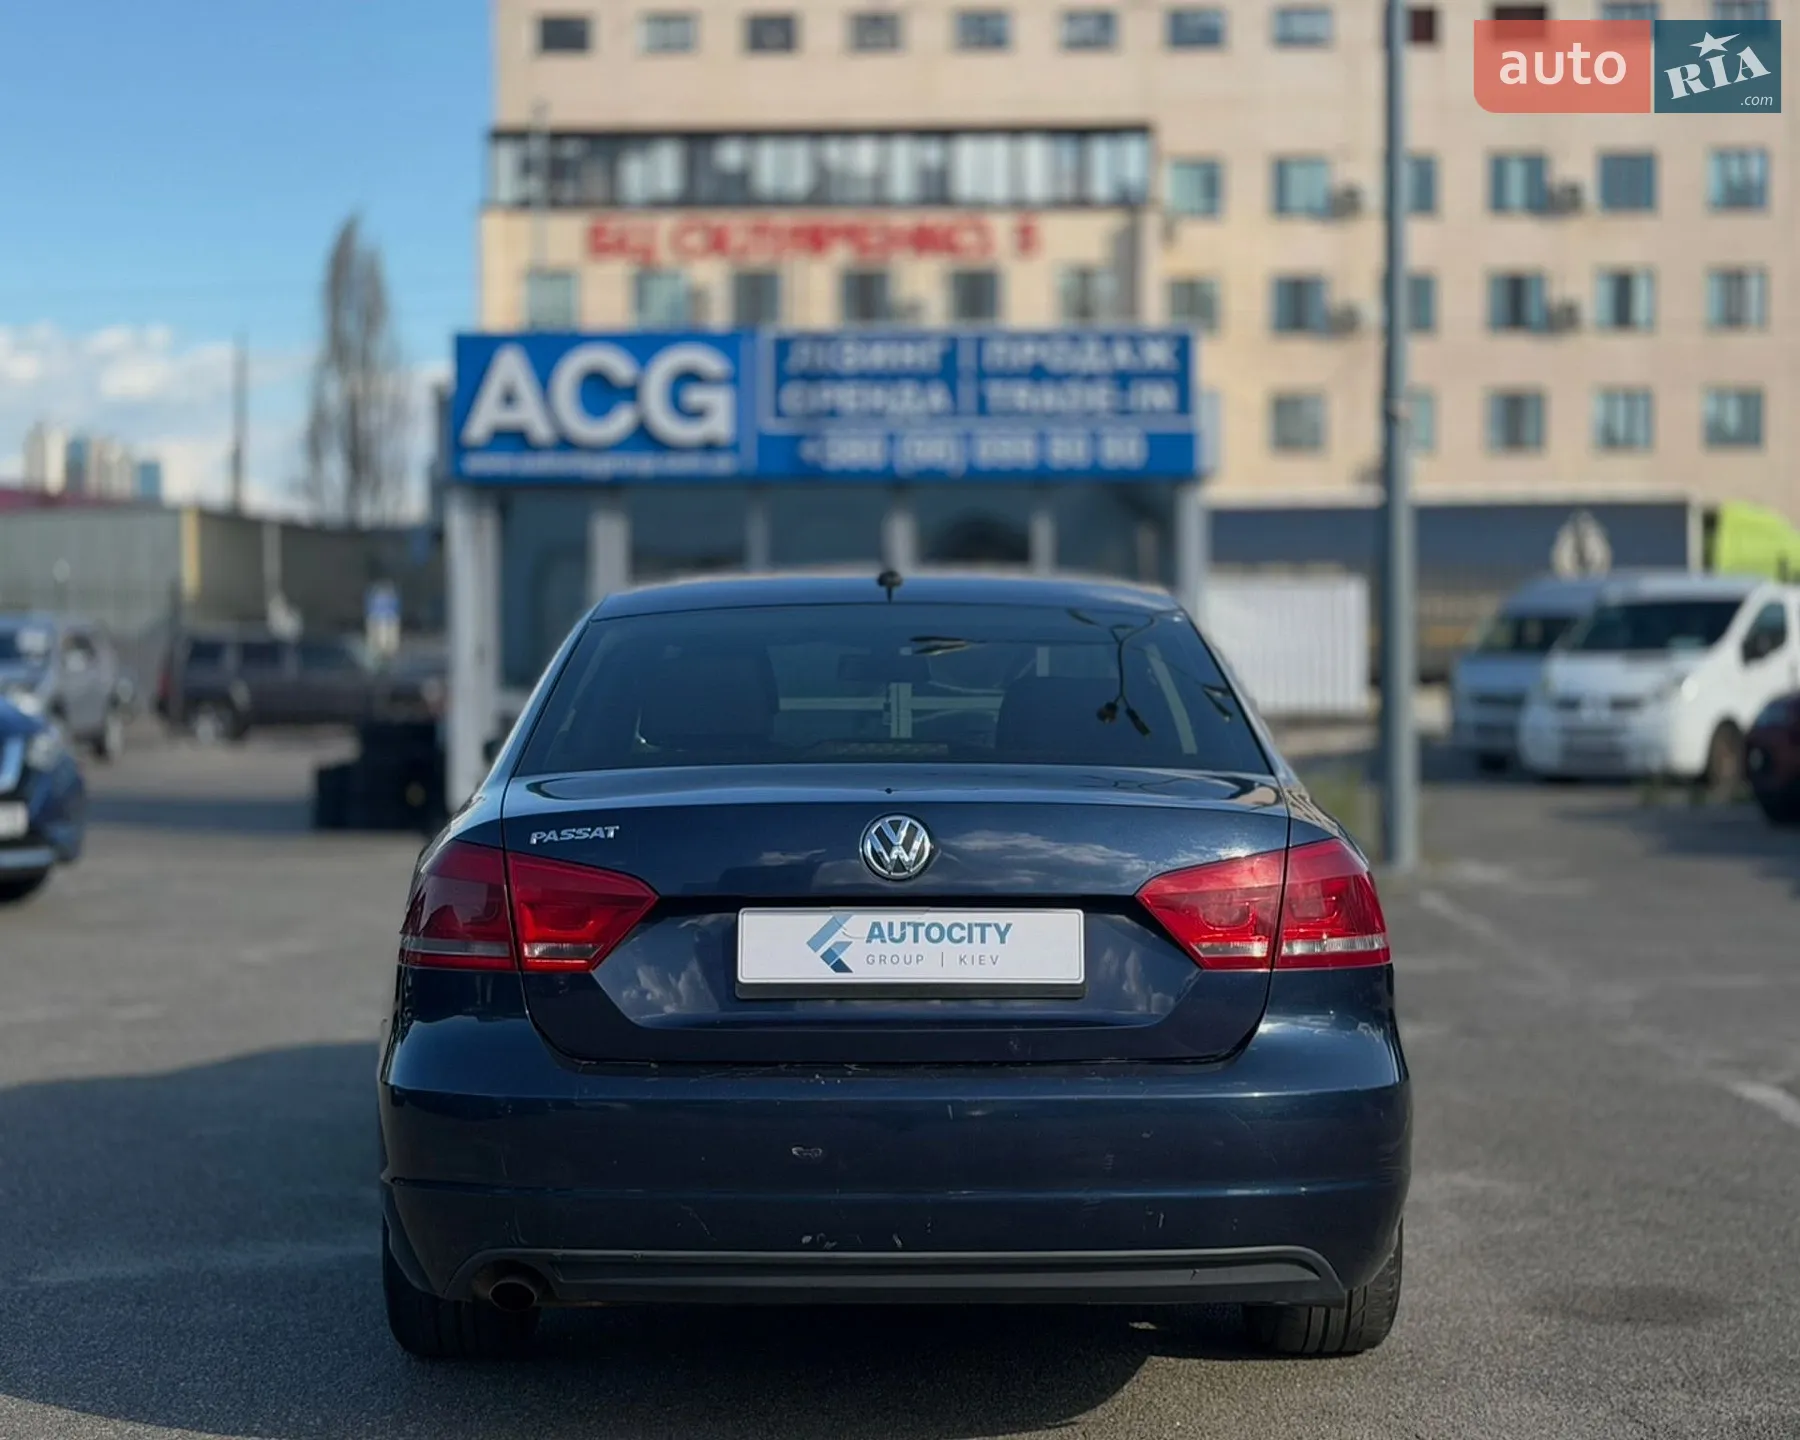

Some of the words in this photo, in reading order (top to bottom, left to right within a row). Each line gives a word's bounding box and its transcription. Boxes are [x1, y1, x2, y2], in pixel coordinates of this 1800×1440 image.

[983, 340, 1177, 373] ПРОДАЖ
[461, 342, 736, 449] ACG
[530, 825, 620, 845] PASSAT
[865, 921, 1013, 945] AUTOCITY
[866, 954, 925, 966] GROUP
[959, 954, 1000, 966] KIEV
